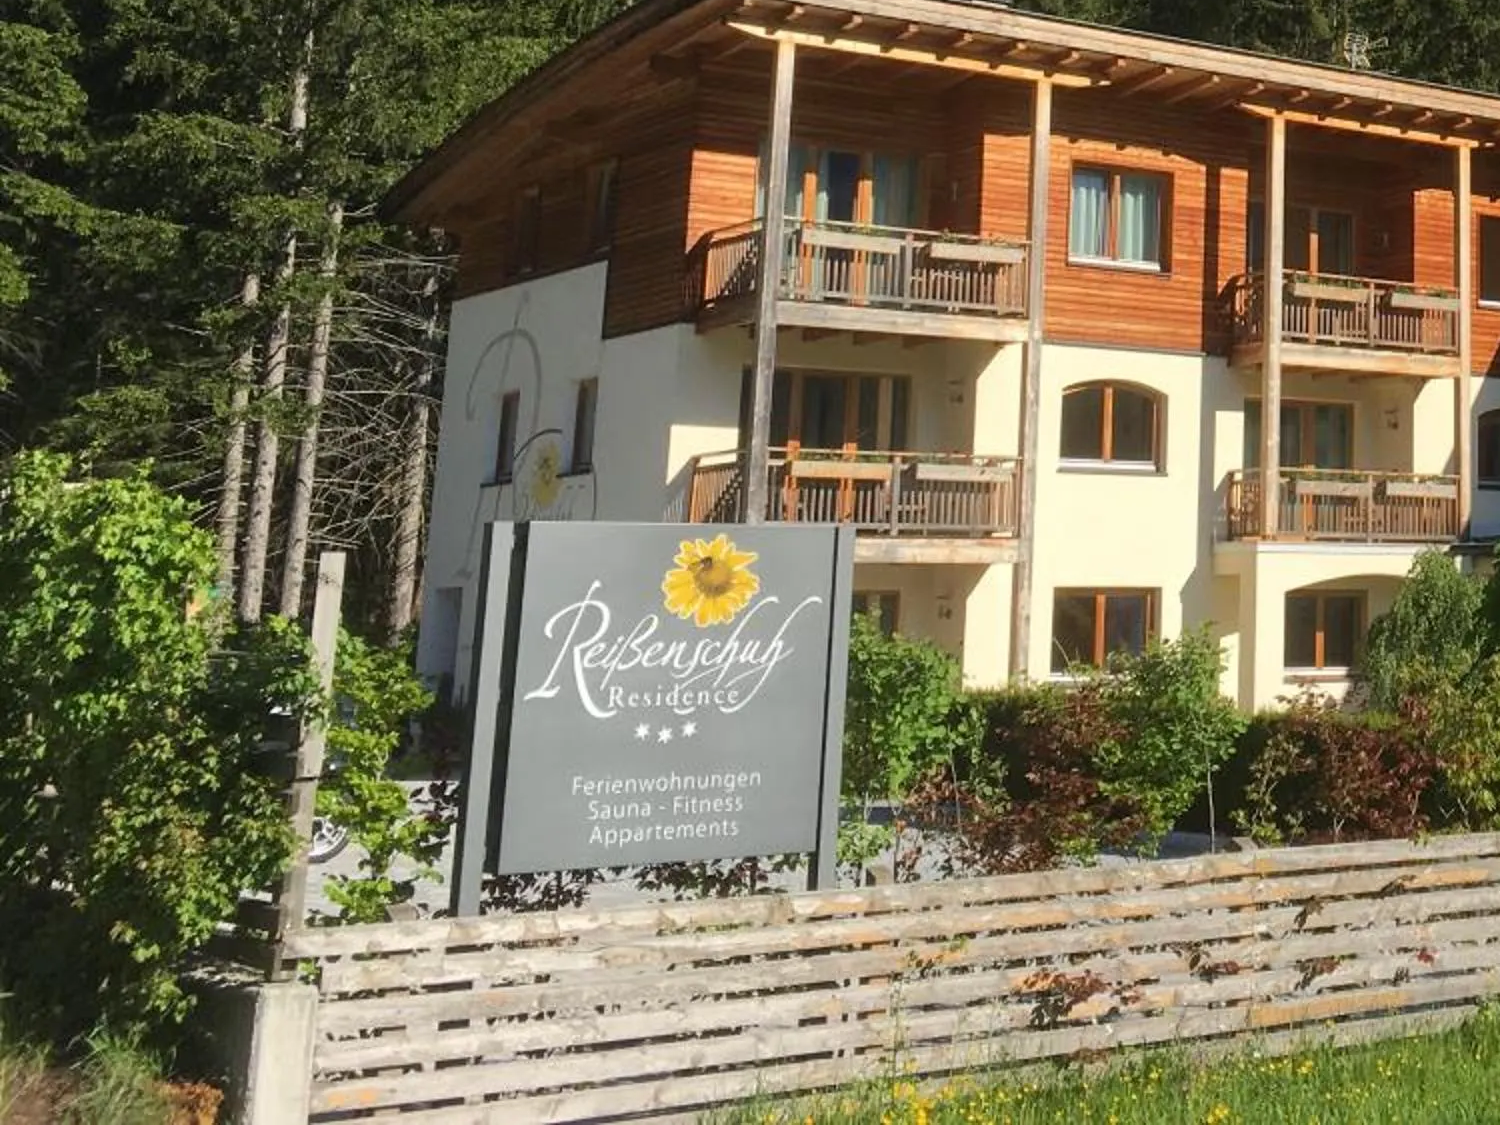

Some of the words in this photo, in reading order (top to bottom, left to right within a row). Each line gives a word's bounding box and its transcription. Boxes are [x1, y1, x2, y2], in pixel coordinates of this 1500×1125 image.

[524, 580, 822, 718] Reißenschuh
[608, 685, 740, 711] Residence
[572, 772, 762, 798] Ferienwohnungen
[587, 801, 651, 821] Sauna
[672, 796, 744, 817] Fitness
[589, 818, 739, 849] Appartements
